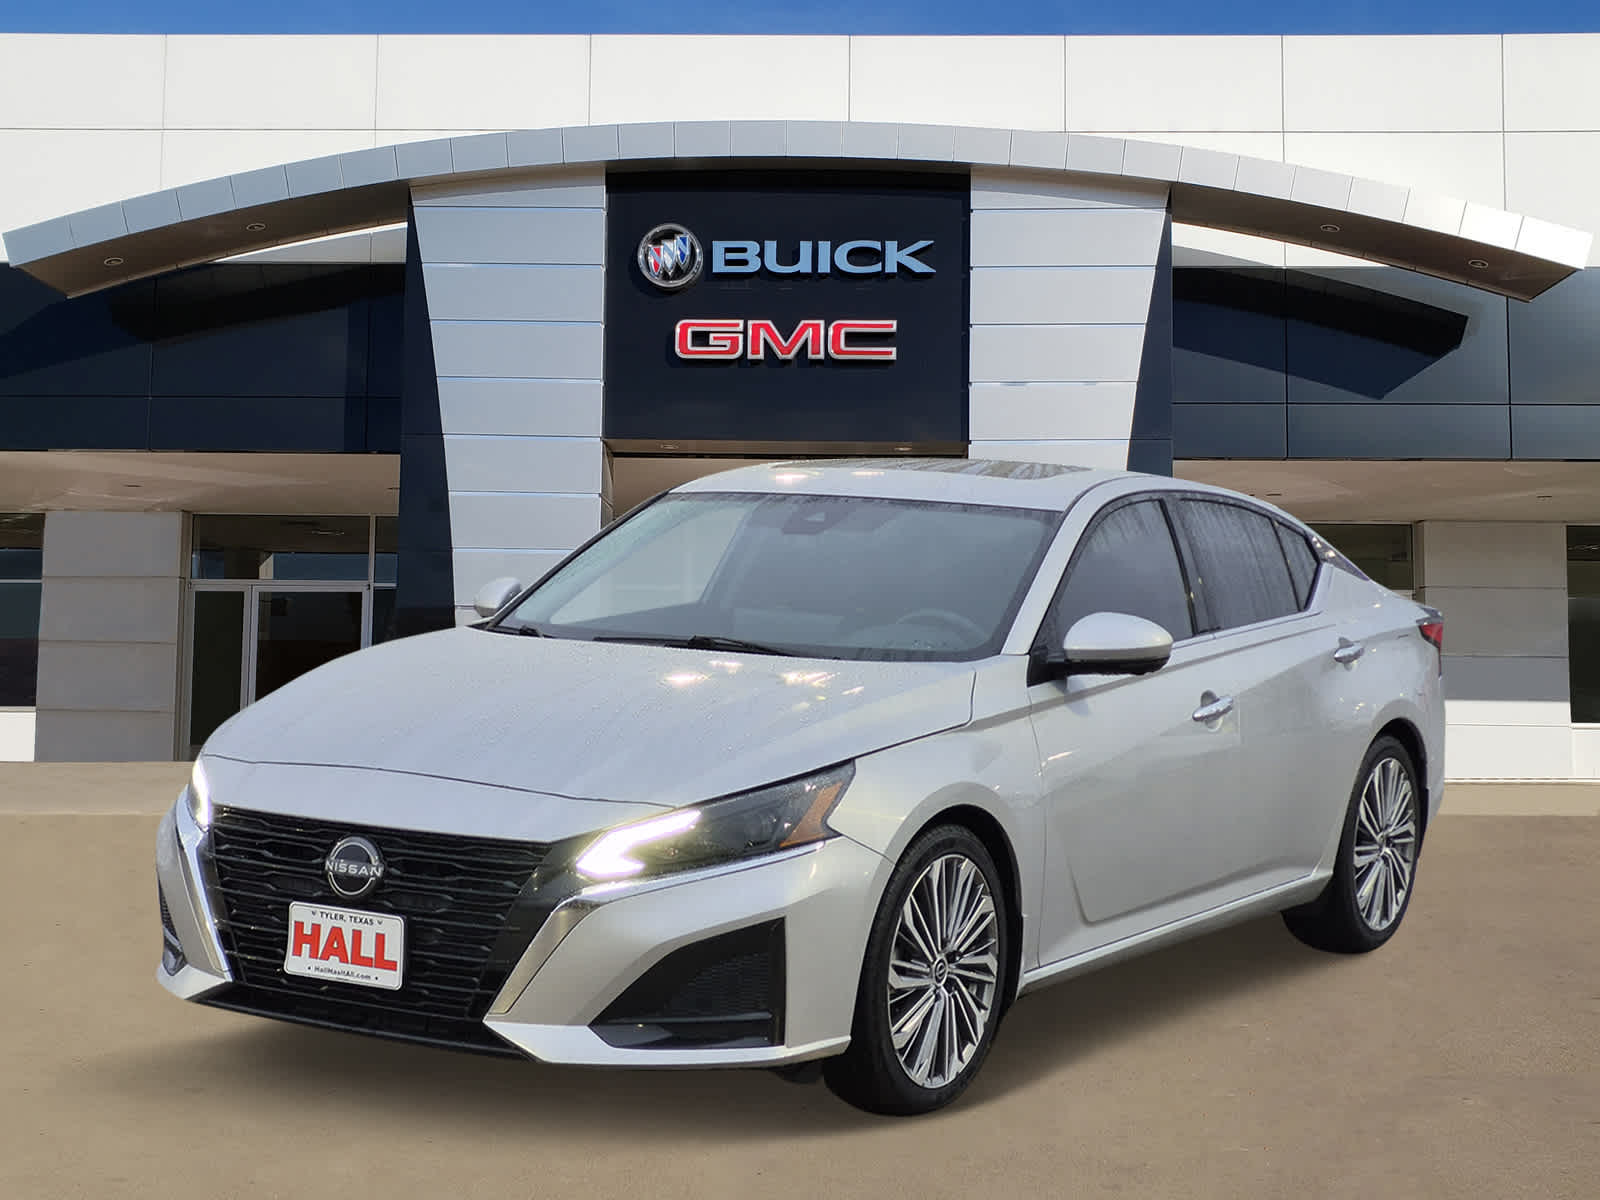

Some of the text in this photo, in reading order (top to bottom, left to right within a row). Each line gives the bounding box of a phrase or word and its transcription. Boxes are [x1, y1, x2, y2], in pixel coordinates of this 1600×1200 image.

[712, 240, 936, 273] BUICK
[675, 319, 897, 360] GMC
[325, 859, 382, 877] NISSAN
[320, 911, 374, 926] TYLER, TEXAS
[292, 920, 398, 971] HALL
